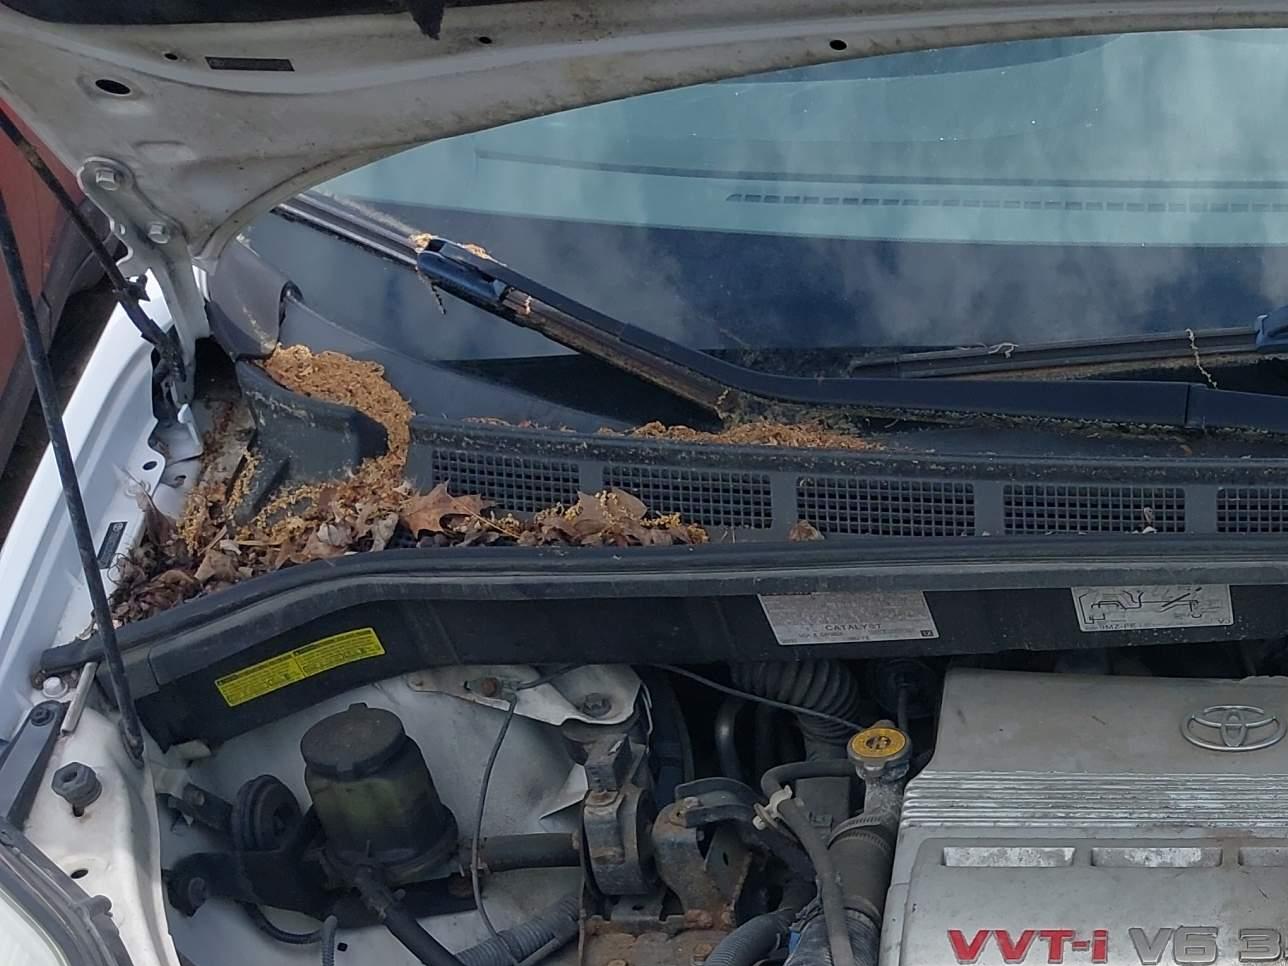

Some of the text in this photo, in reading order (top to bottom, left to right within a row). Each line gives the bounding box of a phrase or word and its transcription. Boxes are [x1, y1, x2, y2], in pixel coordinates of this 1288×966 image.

[824, 622, 882, 631] CATALYST
[948, 928, 1110, 965] VVT-i
[1128, 925, 1220, 966] V6
